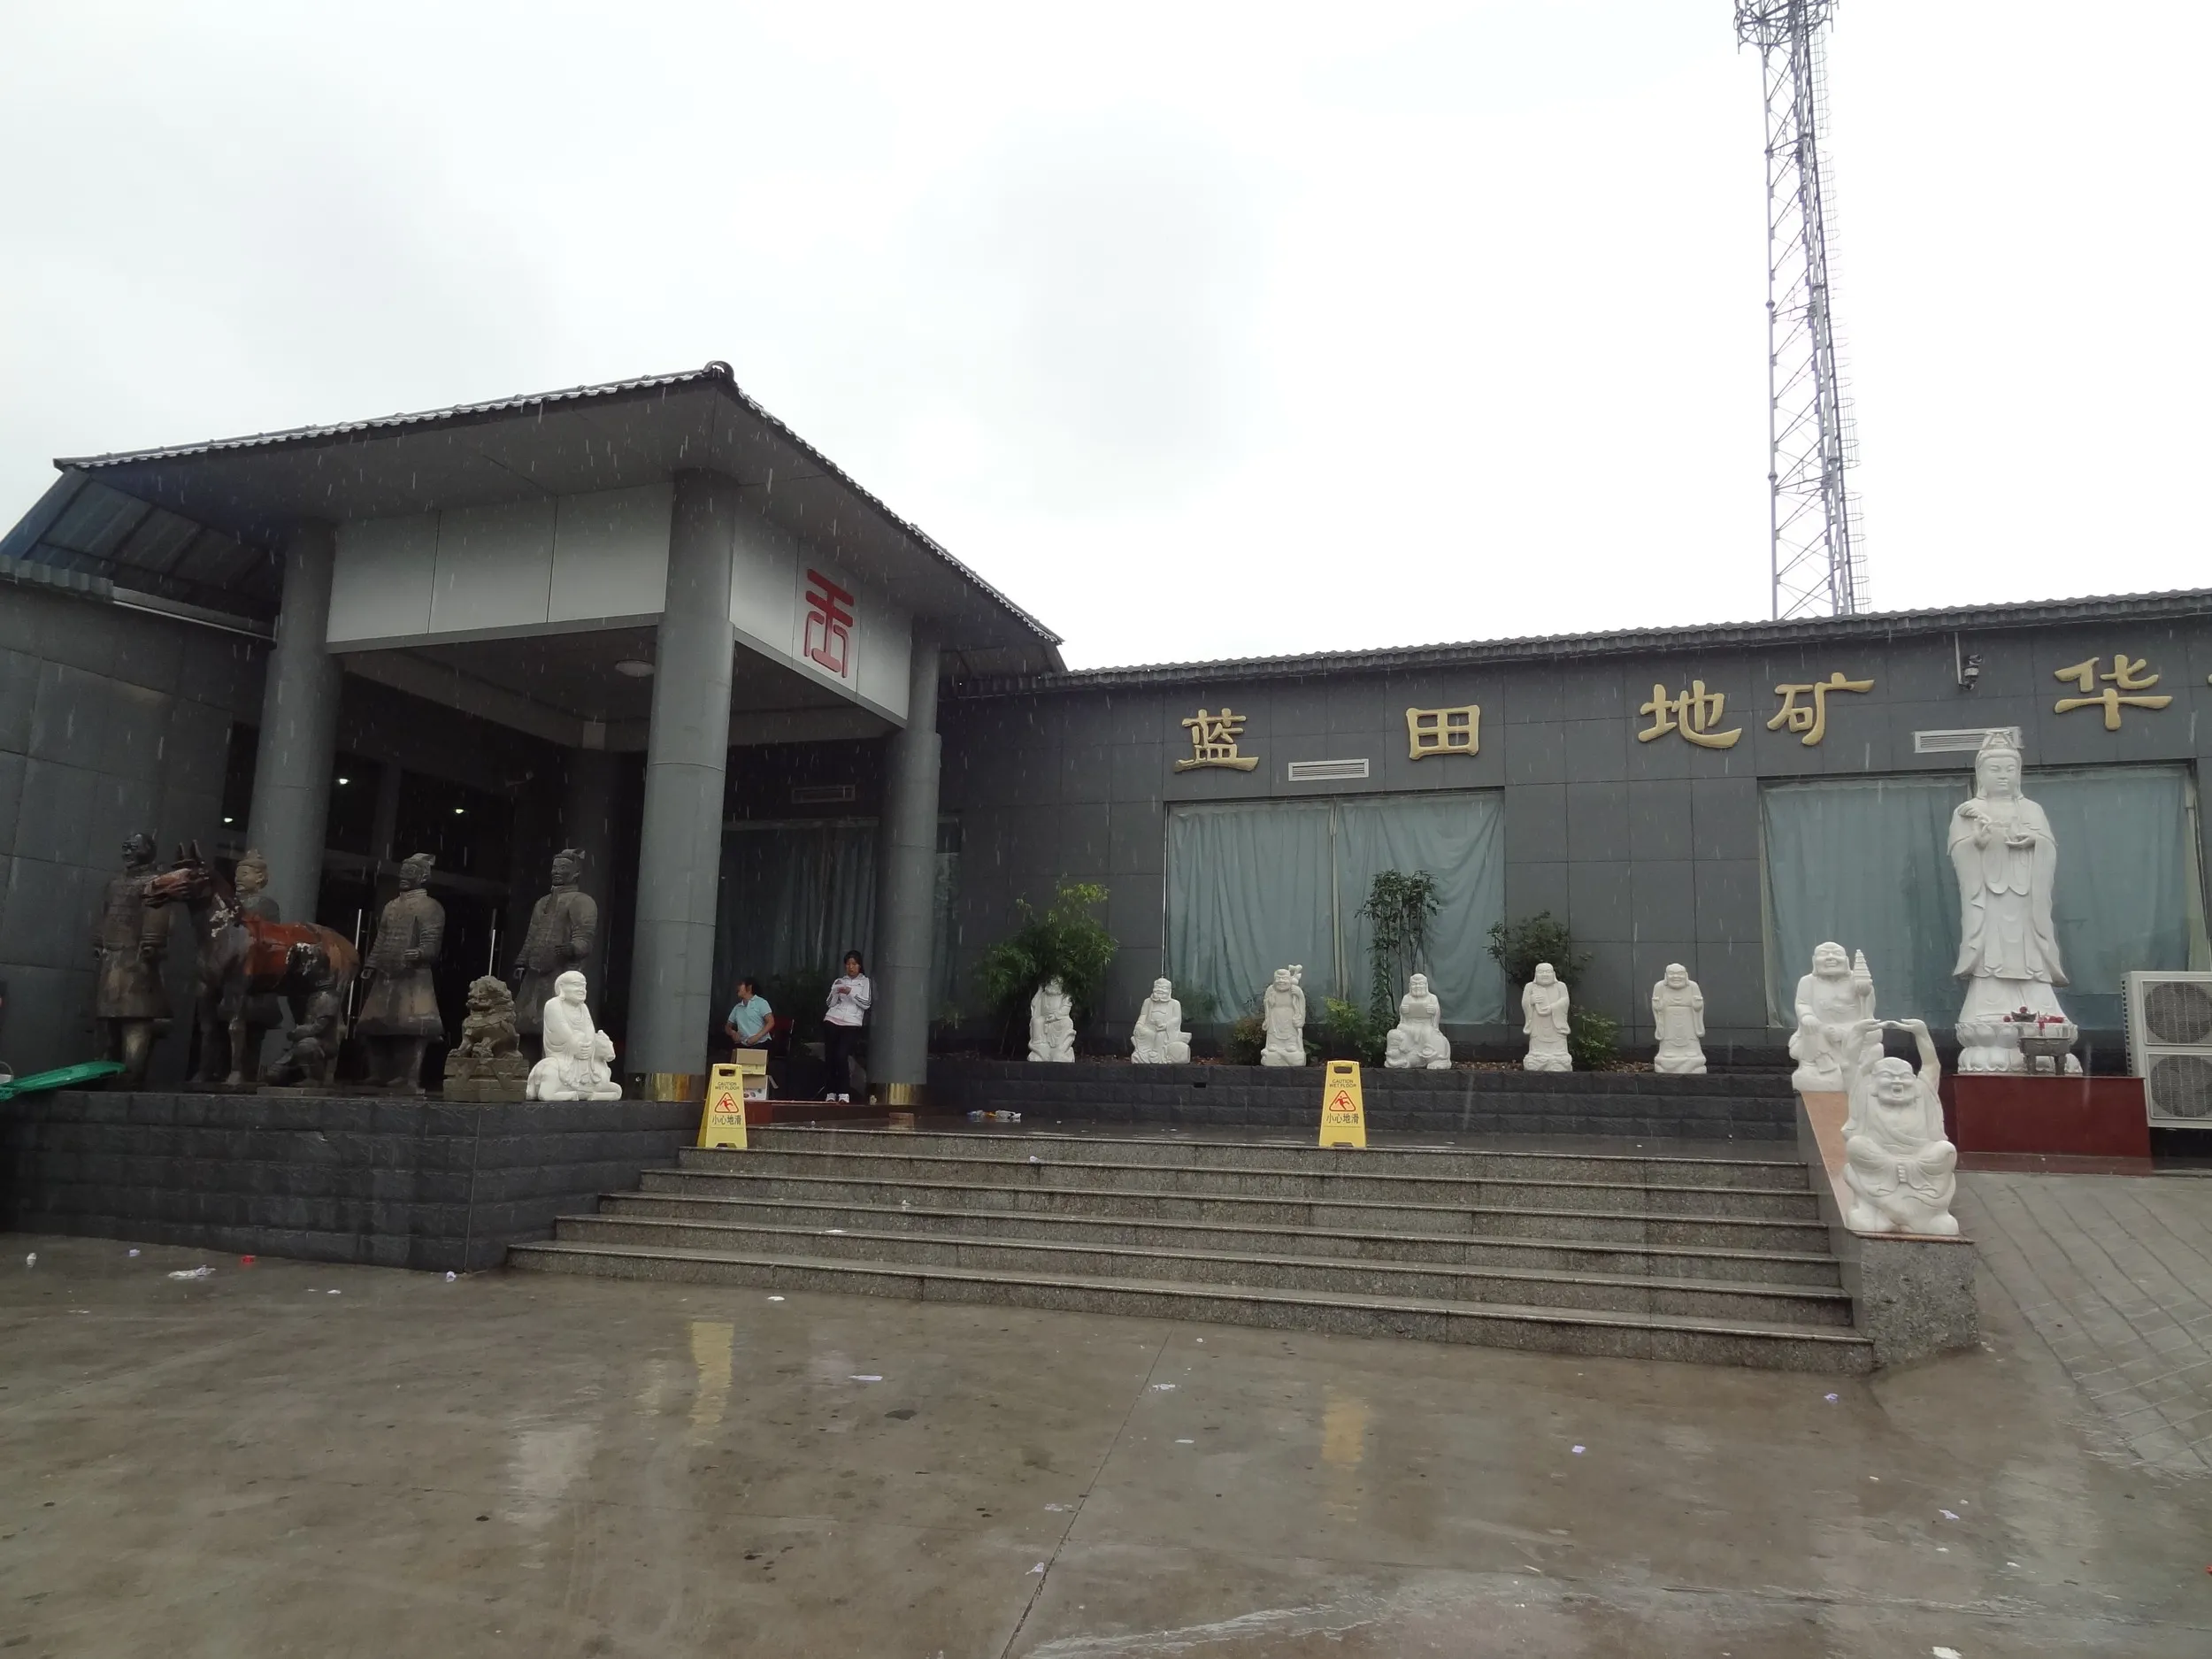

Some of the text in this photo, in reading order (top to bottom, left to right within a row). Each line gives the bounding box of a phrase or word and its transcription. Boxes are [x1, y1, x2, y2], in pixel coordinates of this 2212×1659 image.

[712, 1115, 742, 1125] 小心地滑
[1326, 1113, 1360, 1125] 小心地滑
